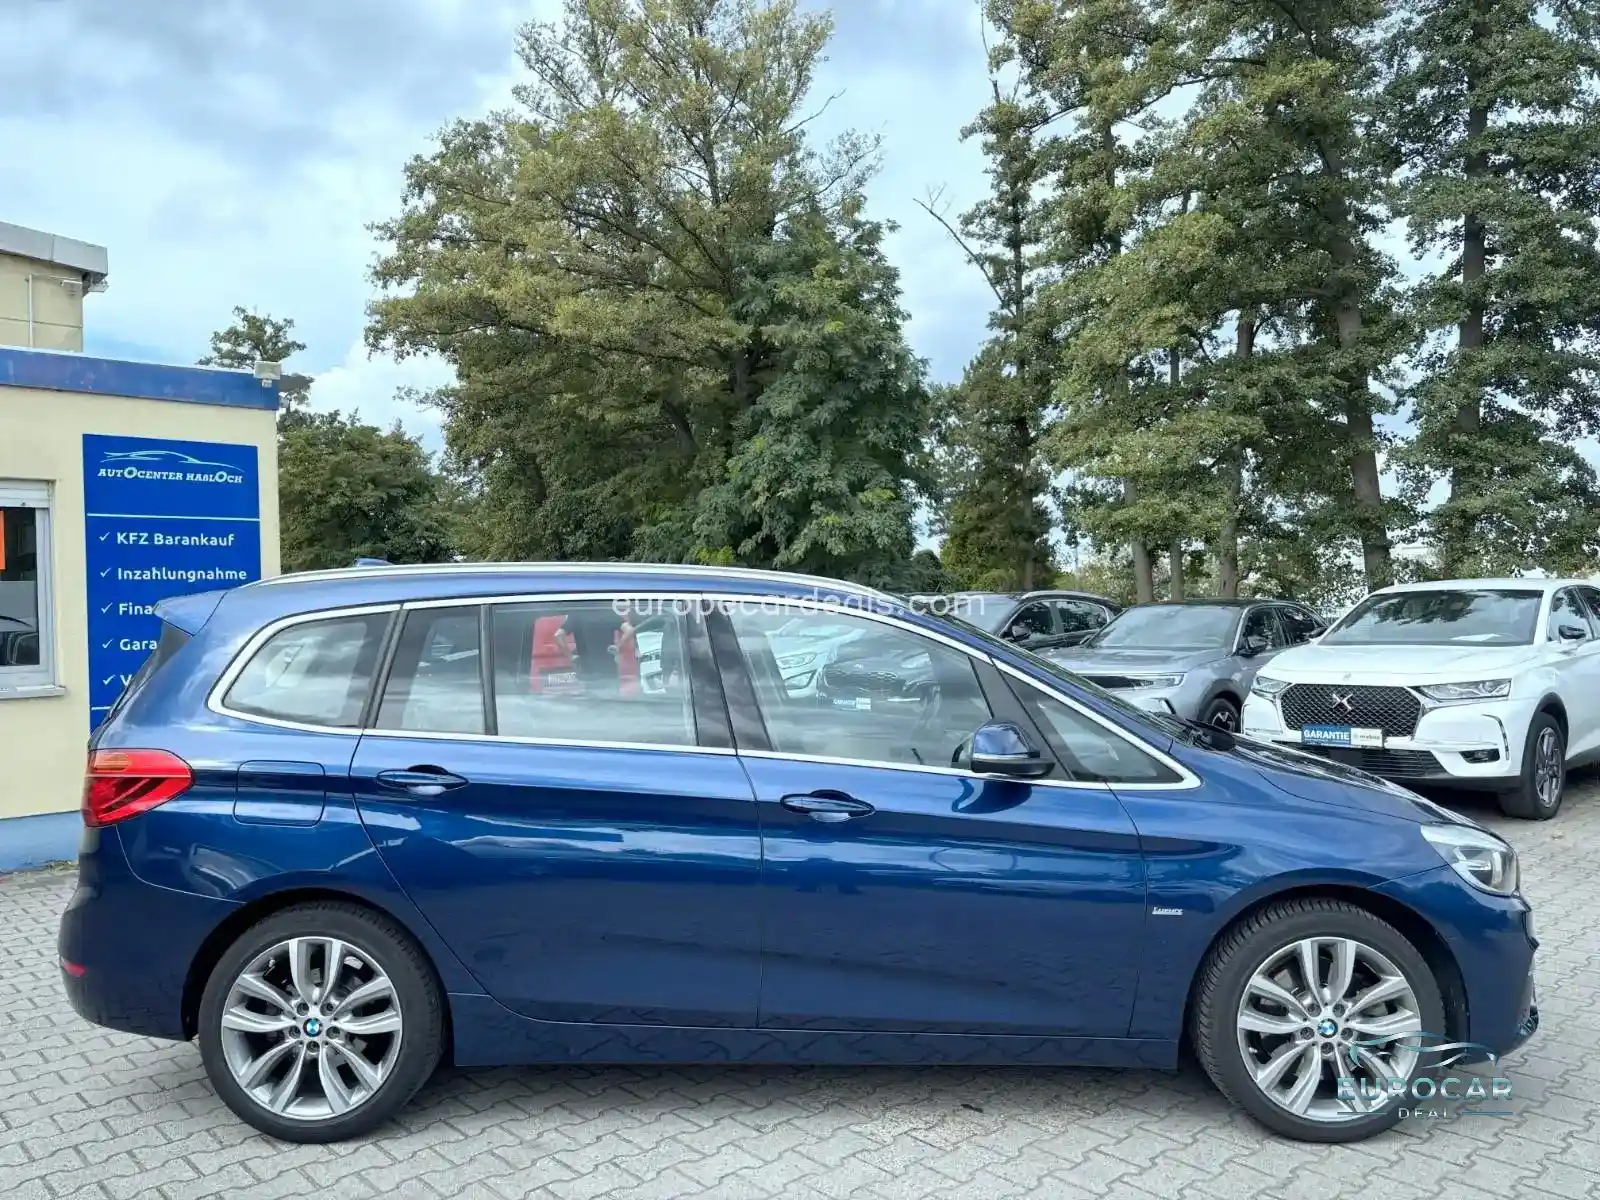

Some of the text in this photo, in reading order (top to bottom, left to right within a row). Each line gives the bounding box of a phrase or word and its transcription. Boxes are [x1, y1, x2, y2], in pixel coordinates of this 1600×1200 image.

[98, 466, 183, 481] AUTOCENTER
[117, 532, 235, 547] KFZ Barankauf
[117, 567, 247, 583] Inzahlungnahme
[119, 602, 153, 616] Fina
[120, 638, 157, 651] Gara
[1303, 729, 1350, 740] GARANTIE
